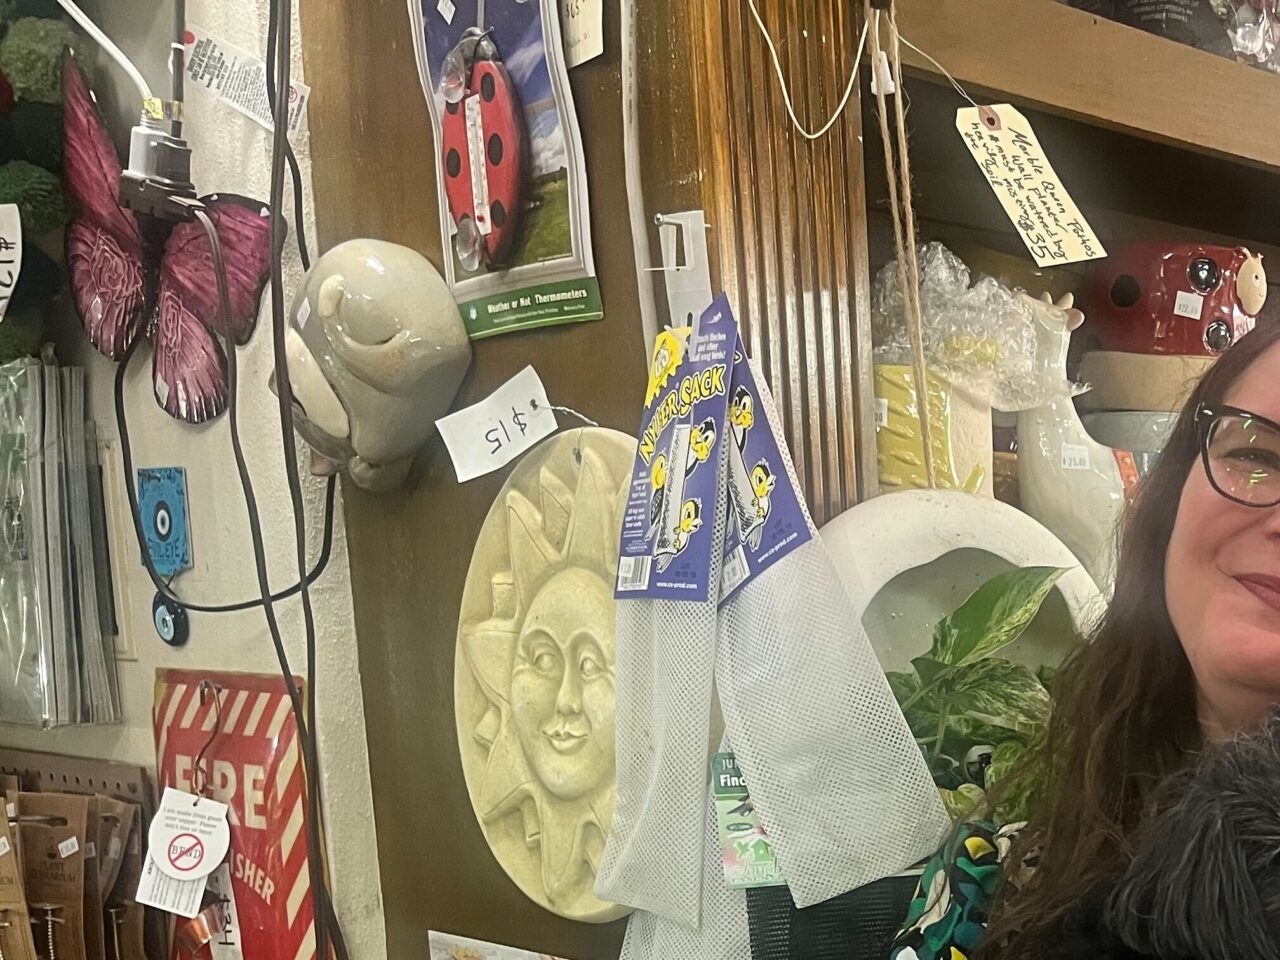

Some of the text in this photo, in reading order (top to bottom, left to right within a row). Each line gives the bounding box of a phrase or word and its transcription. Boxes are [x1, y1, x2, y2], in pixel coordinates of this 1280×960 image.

[1007, 127, 1097, 257] Marble Queen Pothos
[1012, 154, 1034, 180] Wall
[1013, 177, 1025, 190] be
[1026, 196, 1057, 239] watered
[487, 302, 510, 314] Weather
[520, 296, 531, 306] Not
[534, 289, 588, 304] Thermometers
[679, 363, 727, 418] SACK
[485, 406, 527, 454] $15
